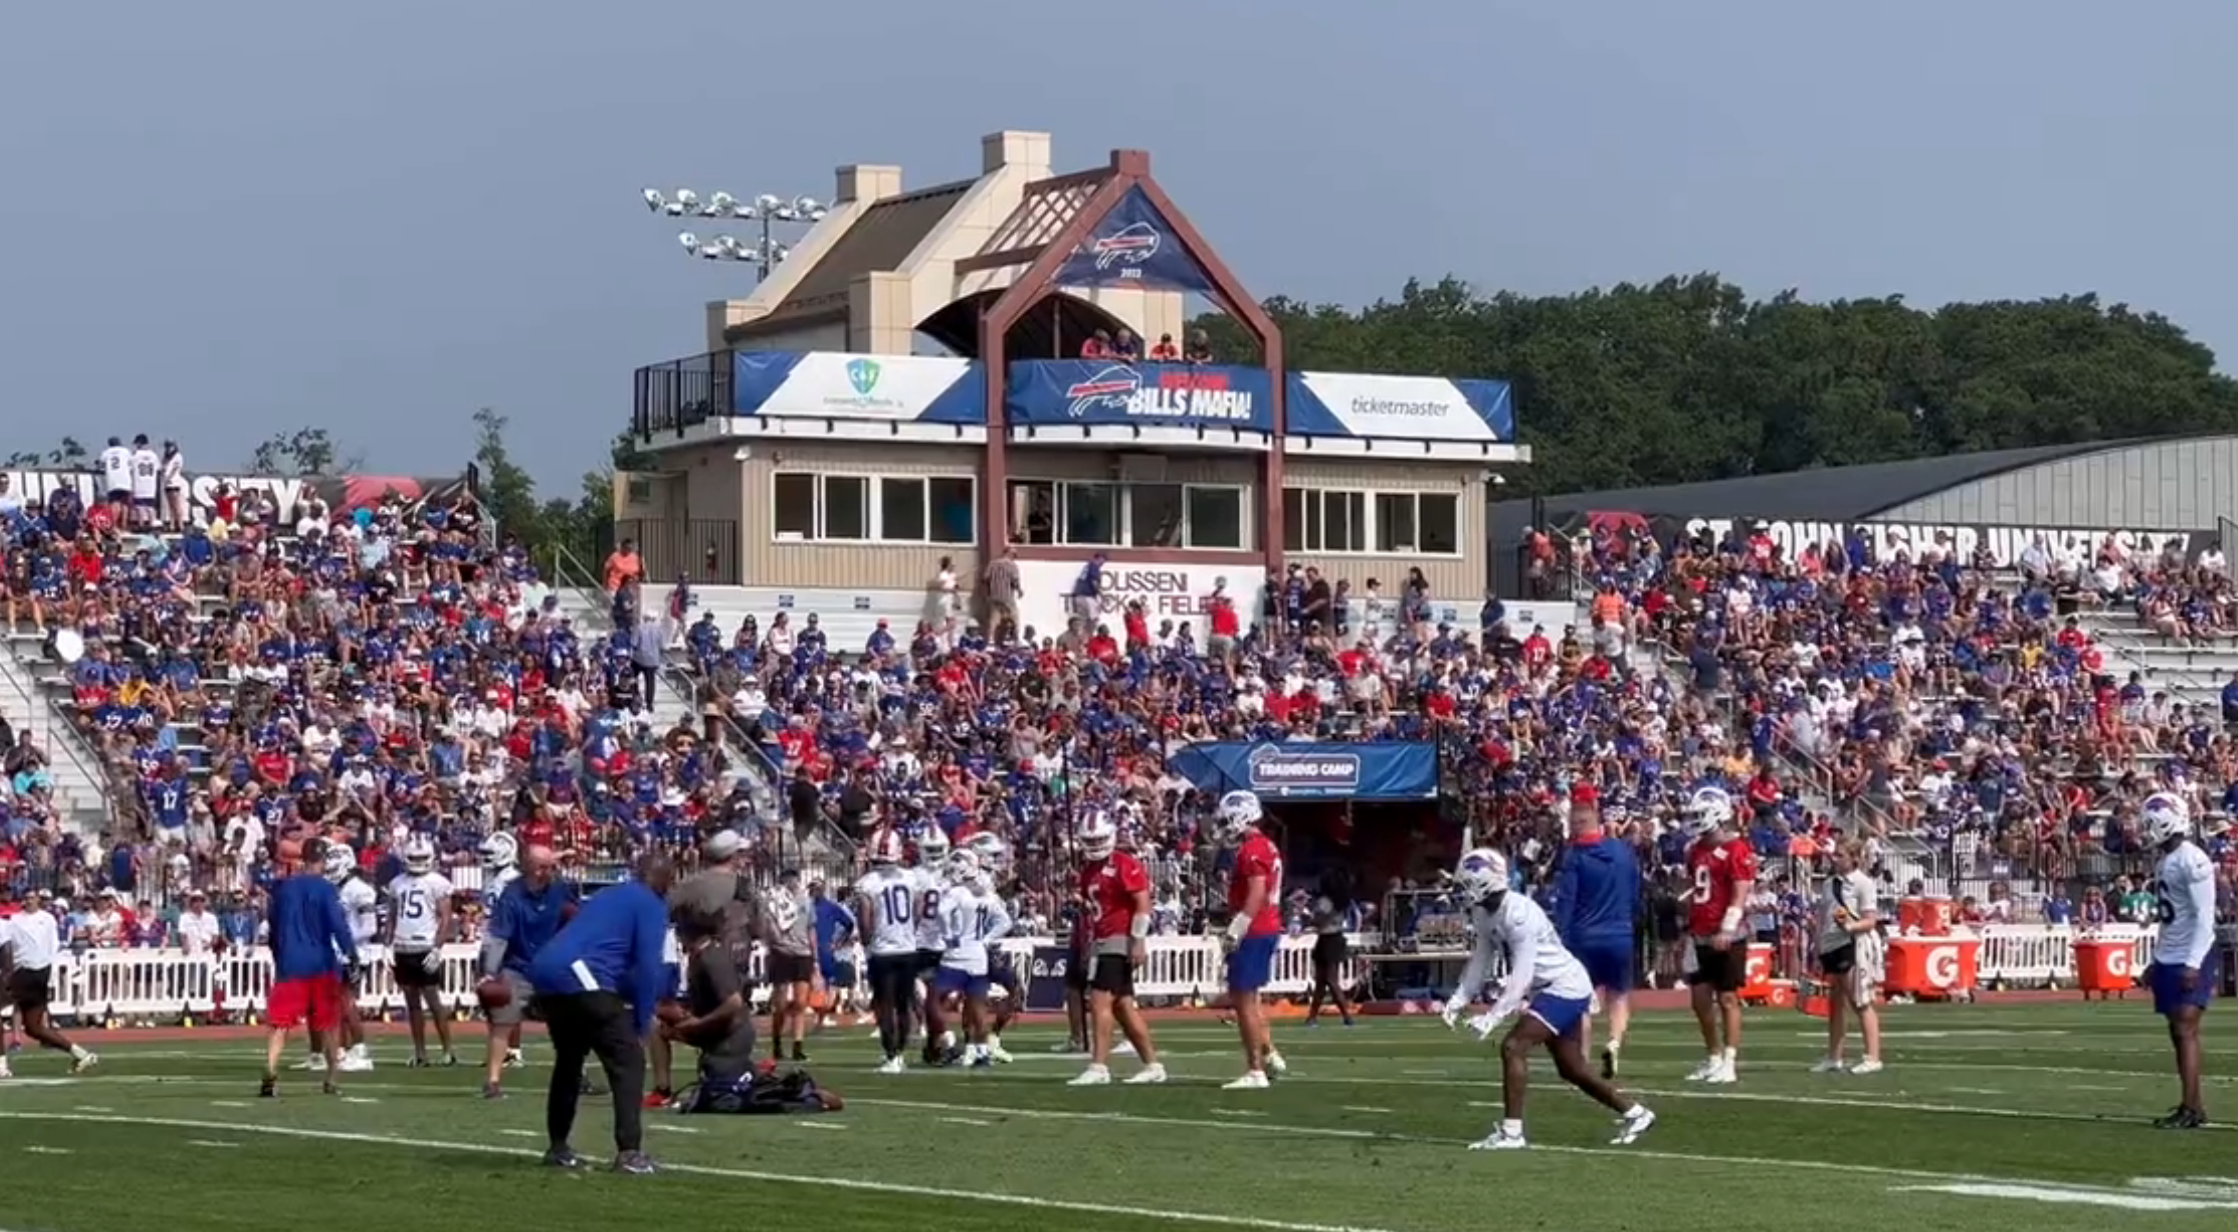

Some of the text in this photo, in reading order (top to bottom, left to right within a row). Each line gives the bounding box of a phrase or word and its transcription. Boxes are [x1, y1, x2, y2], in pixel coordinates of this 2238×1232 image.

[1127, 387, 1252, 419] BILLS MAFIA!
[1351, 396, 1449, 416] ticketmaster
[1751, 519, 1844, 565] OHN
[1099, 571, 1188, 592] OLISSENI
[1059, 593, 1129, 614] TCK
[1533, 647, 1546, 662] 17
[1259, 763, 1355, 777] TRAINING CAMP
[163, 789, 178, 810] 17
[1693, 865, 1711, 904] 9
[399, 890, 424, 919] 15
[881, 885, 912, 926] 10
[1926, 946, 1959, 988] G
[2107, 950, 2127, 977] G
[1772, 987, 1785, 1005] G
